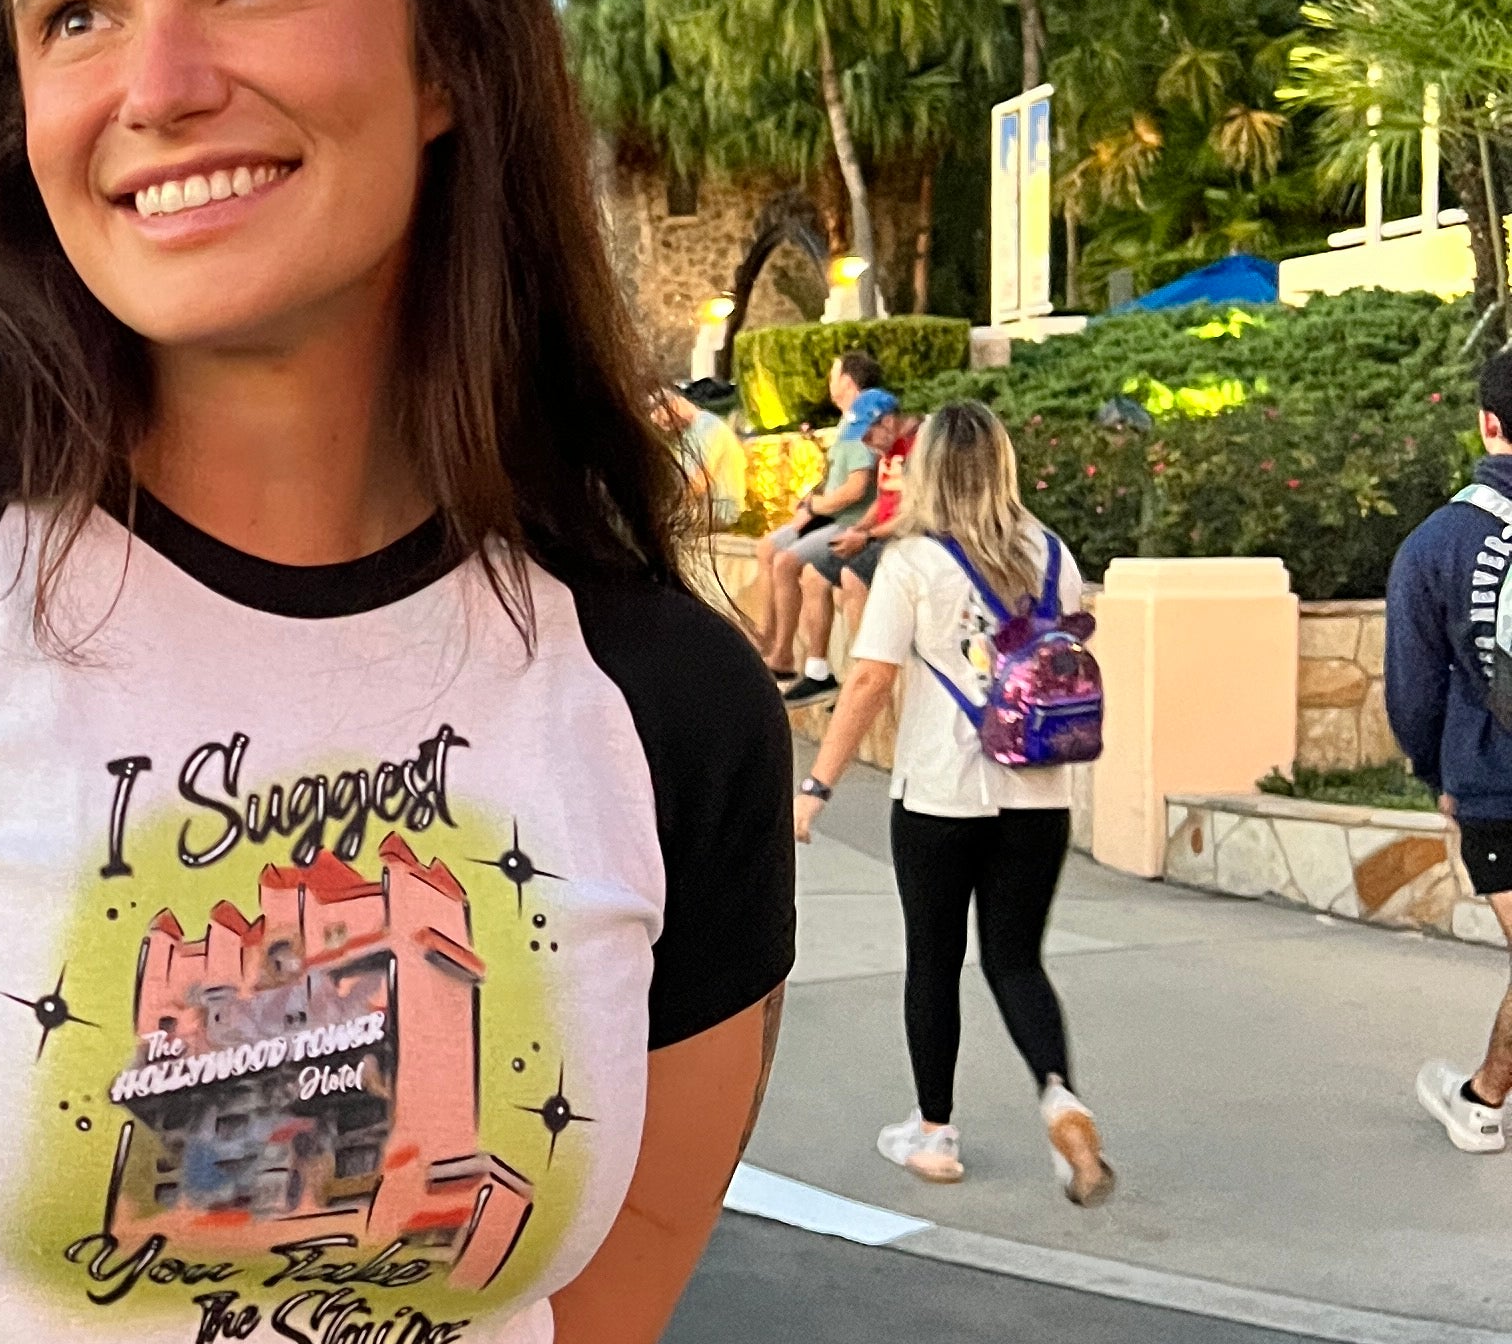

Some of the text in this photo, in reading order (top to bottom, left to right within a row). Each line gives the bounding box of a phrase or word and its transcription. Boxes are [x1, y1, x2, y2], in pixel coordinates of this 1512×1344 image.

[100, 723, 471, 879] I Suggest
[110, 1011, 385, 1101] HOLLYWOOD TOWER
[141, 1029, 186, 1061] The
[298, 1061, 365, 1100] Hotel
[64, 1234, 437, 1306] You Take
